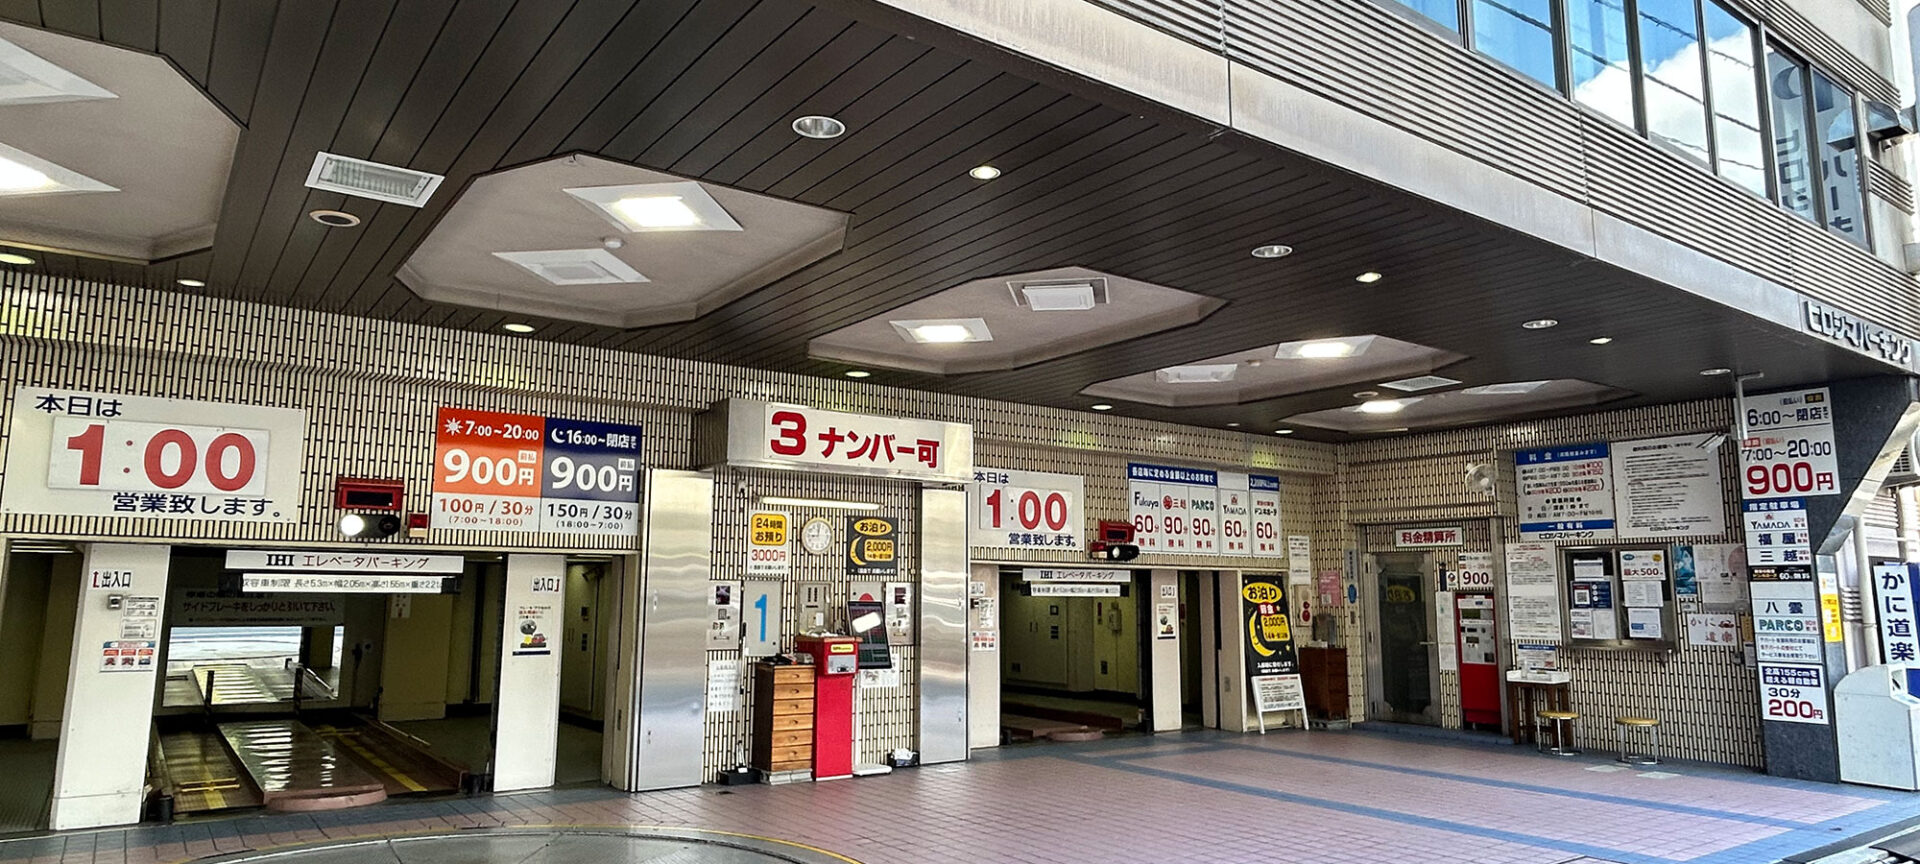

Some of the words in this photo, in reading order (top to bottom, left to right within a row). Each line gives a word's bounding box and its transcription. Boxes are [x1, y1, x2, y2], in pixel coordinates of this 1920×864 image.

[1804, 300, 1912, 365] ヒロシマパーキング
[35, 394, 122, 417] 本日は
[67, 424, 256, 491] 1:00
[443, 448, 534, 486] 900円
[550, 456, 633, 492] 900円
[974, 471, 1009, 484] 本日は
[1747, 462, 1834, 495] 900円
[113, 492, 280, 518] 営業致します。
[1134, 492, 1159, 509] Fukuya
[1191, 499, 1214, 511] PARCO
[1749, 501, 1800, 511] 指定駐車場
[986, 489, 1068, 531] 1:00
[1223, 505, 1247, 515] YAMADA
[756, 517, 782, 529] 24時間
[859, 521, 887, 533] お泊り
[1135, 515, 1160, 533] 60分
[1164, 516, 1188, 534] 90分
[1193, 518, 1216, 536] 90分
[1224, 520, 1247, 538] 60分
[1256, 522, 1278, 539] 60分
[1751, 521, 1790, 529] YAMADA
[755, 531, 783, 542] お預り
[1008, 532, 1076, 547] 営業致します。
[1402, 530, 1456, 544] 料金精算所
[866, 541, 892, 552] 2,000円
[266, 554, 295, 566] IHI
[302, 556, 429, 569] エレベータパーキング
[751, 549, 786, 562] 3000円
[1760, 550, 1798, 562] 三越
[101, 571, 131, 588] 出入口
[1040, 571, 1053, 579] IHI
[1057, 571, 1115, 580] エレベータパーキング
[533, 578, 554, 592] 出入口
[1248, 587, 1277, 600] お泊り
[1765, 601, 1803, 614] 八雲
[755, 594, 767, 642] 1
[1882, 572, 1914, 661] かに道楽
[1759, 619, 1803, 631] PARCO
[1768, 688, 1800, 698] 30分
[1768, 699, 1823, 719] 200円
